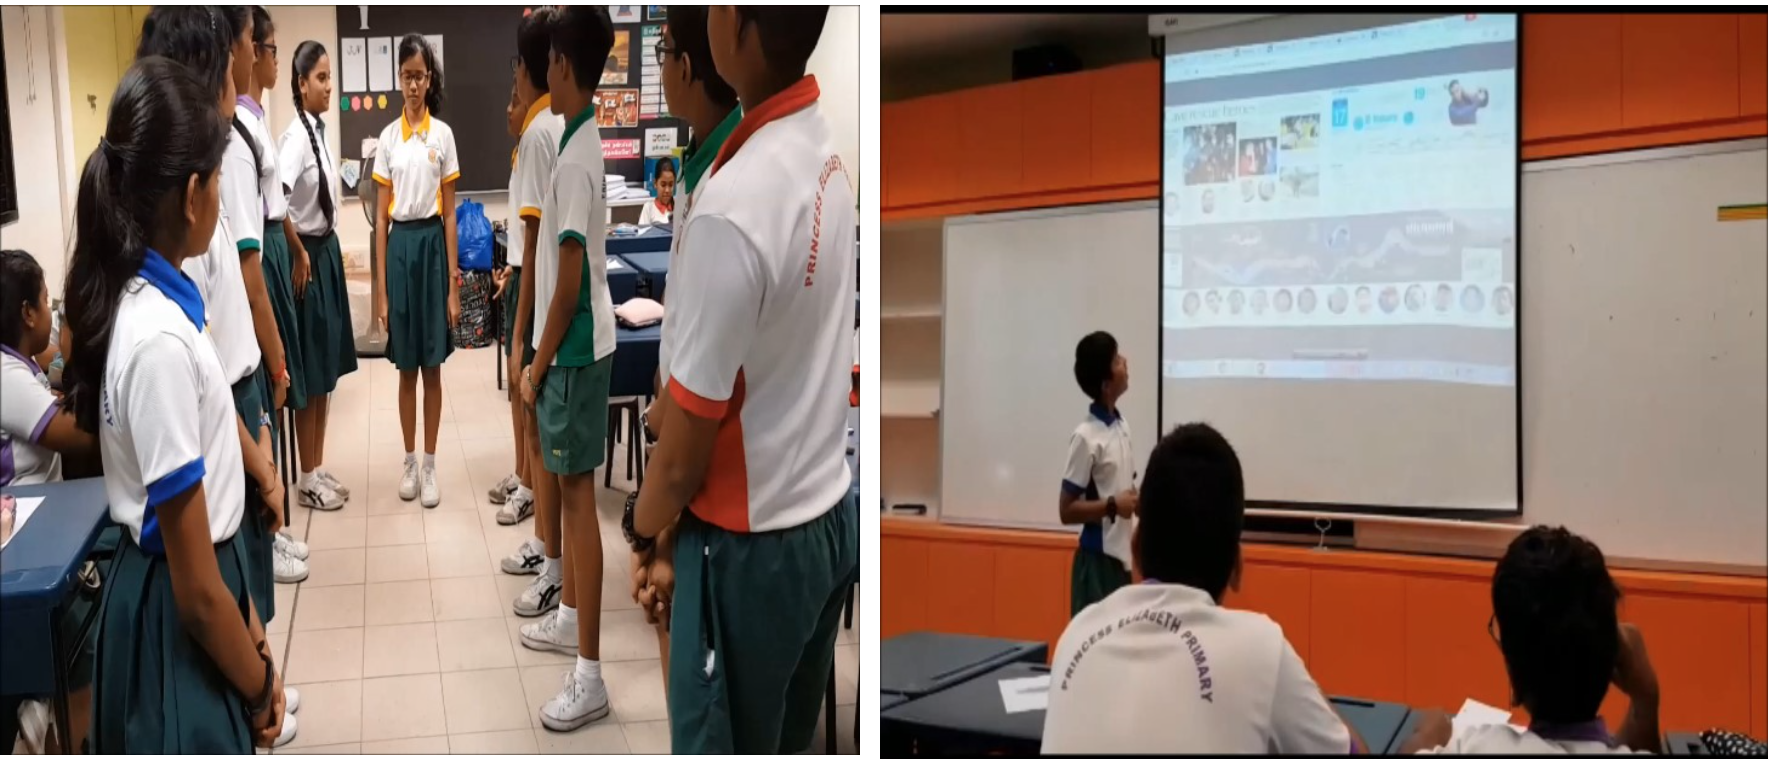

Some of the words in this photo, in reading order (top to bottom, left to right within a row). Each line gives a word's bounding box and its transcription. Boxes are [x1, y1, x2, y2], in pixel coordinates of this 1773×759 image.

[804, 192, 823, 287] PRINCESS
[1061, 624, 1114, 691] PRINCESS
[1117, 608, 1183, 634] ELIZABETH
[1180, 629, 1214, 704] PRIMARY
